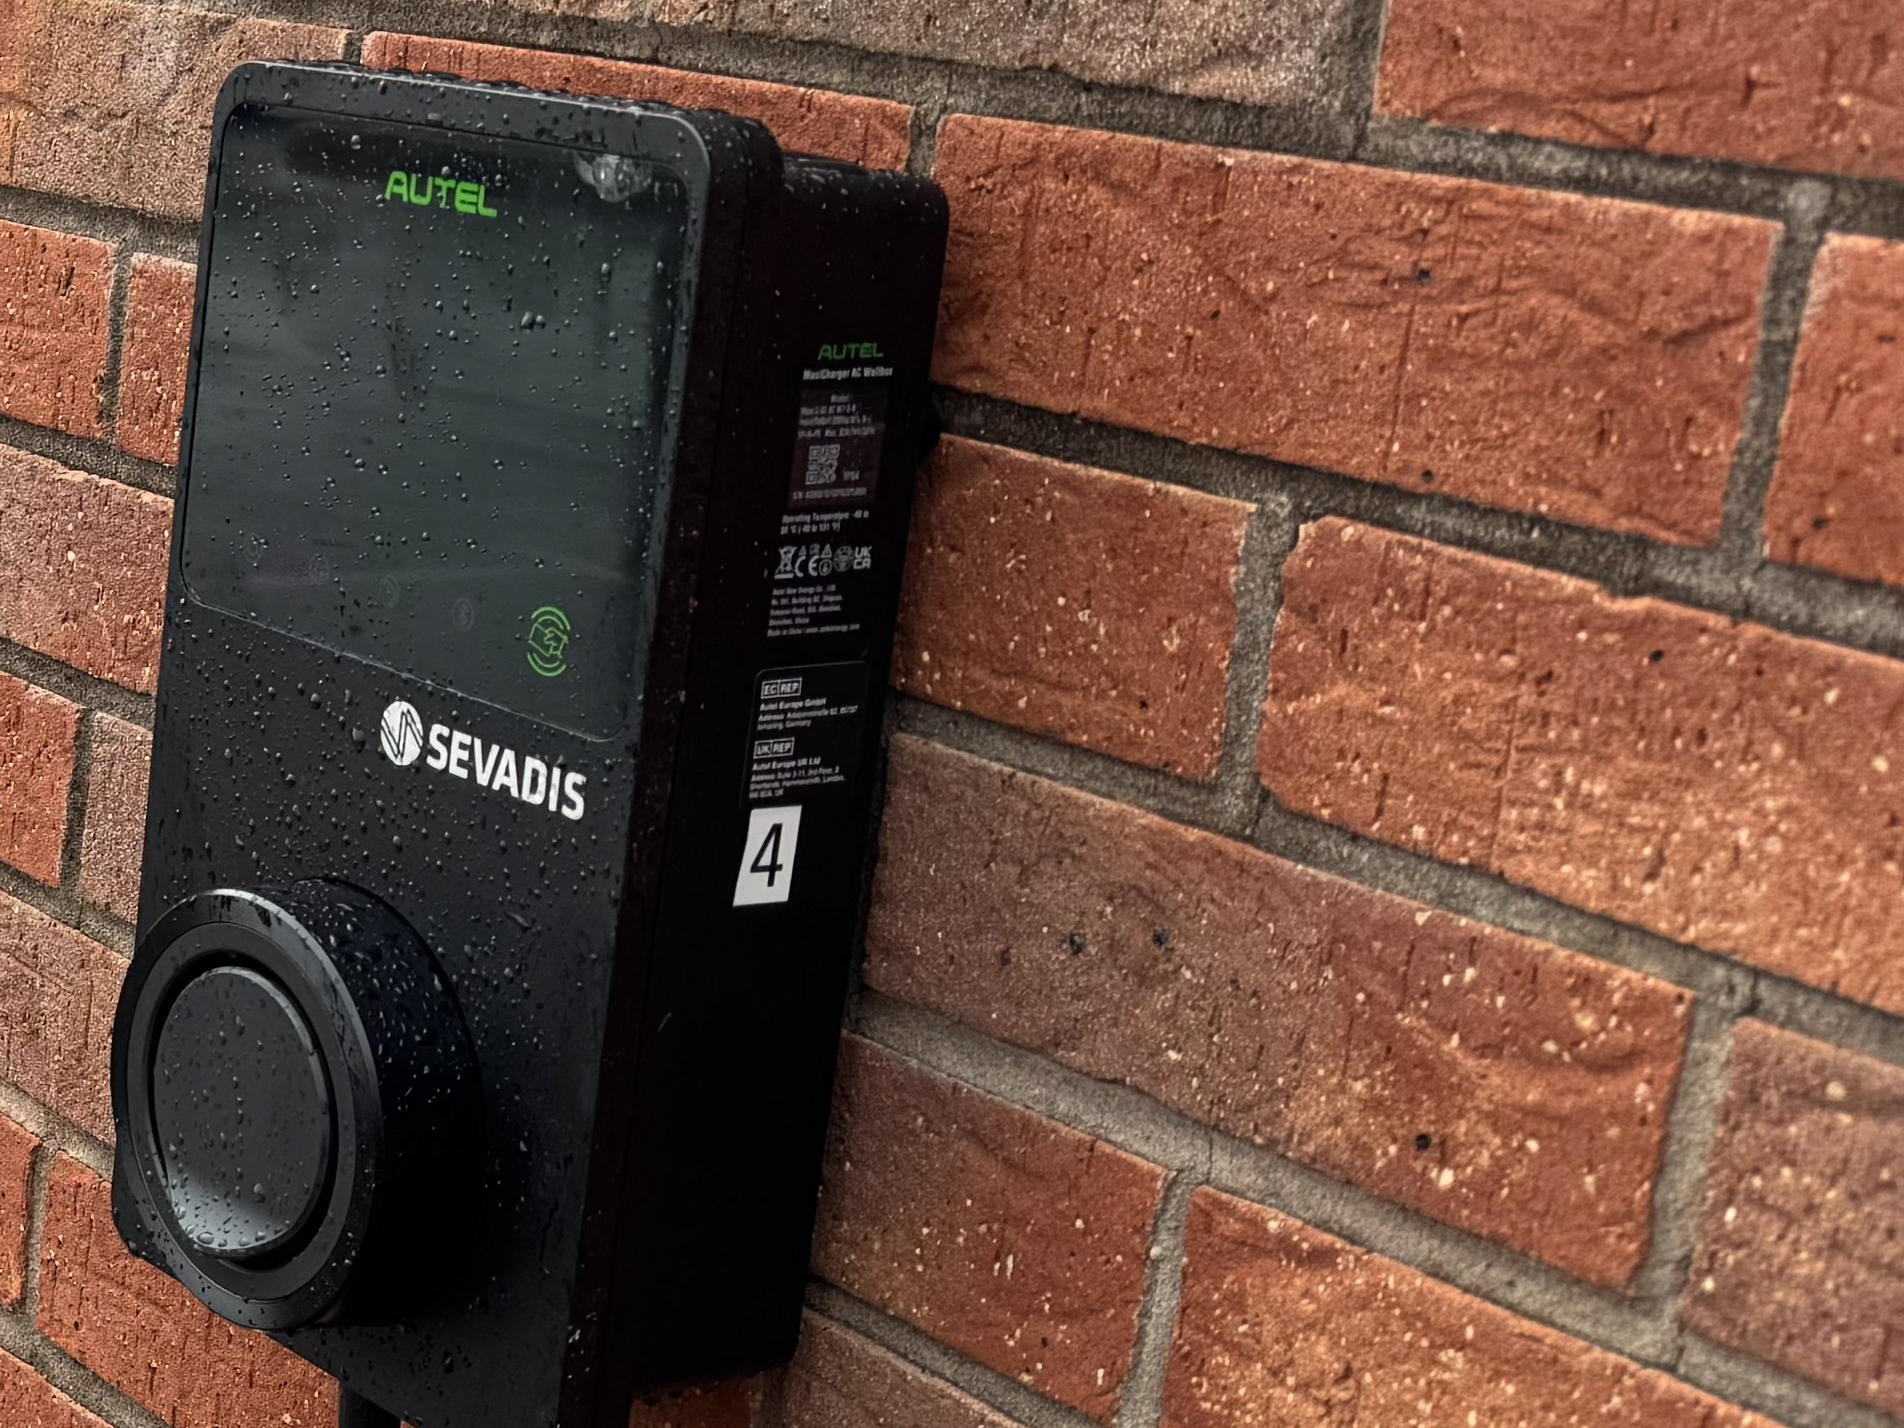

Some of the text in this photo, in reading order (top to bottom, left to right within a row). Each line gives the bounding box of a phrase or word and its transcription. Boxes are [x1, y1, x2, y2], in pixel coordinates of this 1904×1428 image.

[384, 171, 497, 218] AUTEL
[817, 342, 884, 360] AUTEL
[426, 723, 587, 821] SEVADIS
[750, 822, 783, 887] 4
